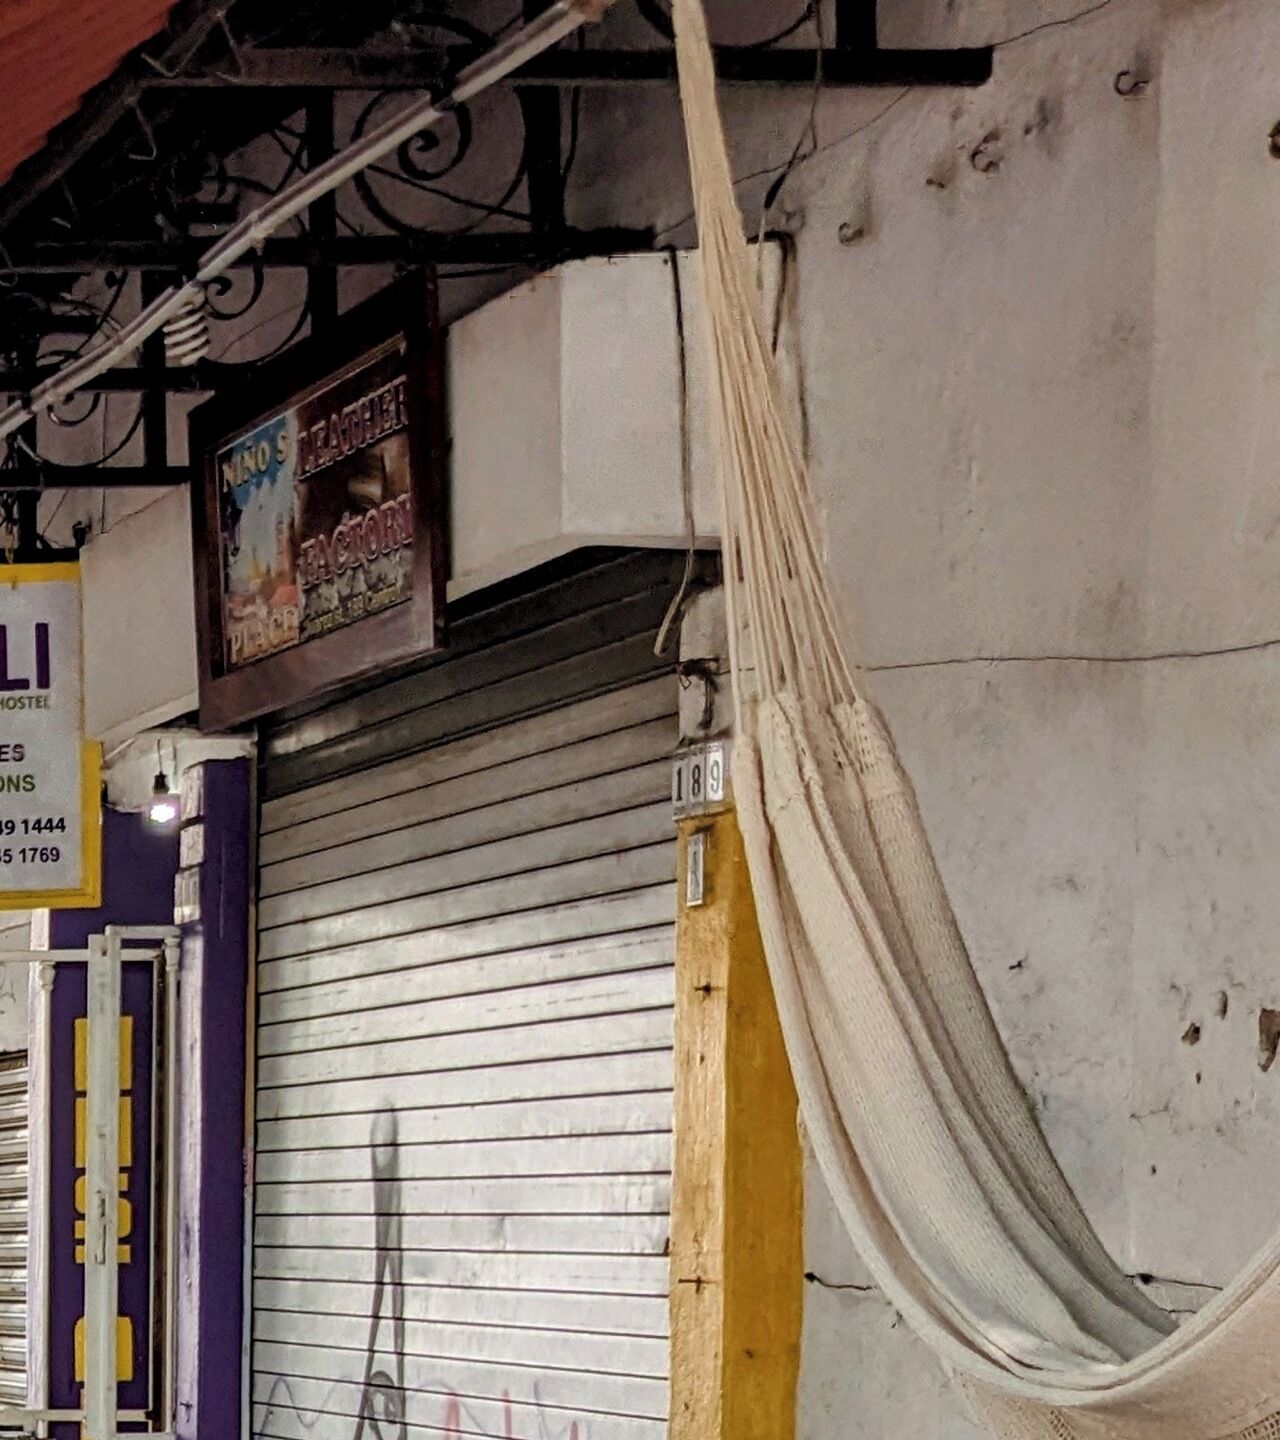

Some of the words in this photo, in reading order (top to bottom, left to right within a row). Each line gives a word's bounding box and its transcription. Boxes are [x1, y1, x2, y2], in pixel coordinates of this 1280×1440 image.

[675, 760, 720, 802] 189
[20, 817, 67, 835] 1444
[18, 846, 61, 863] 1769
